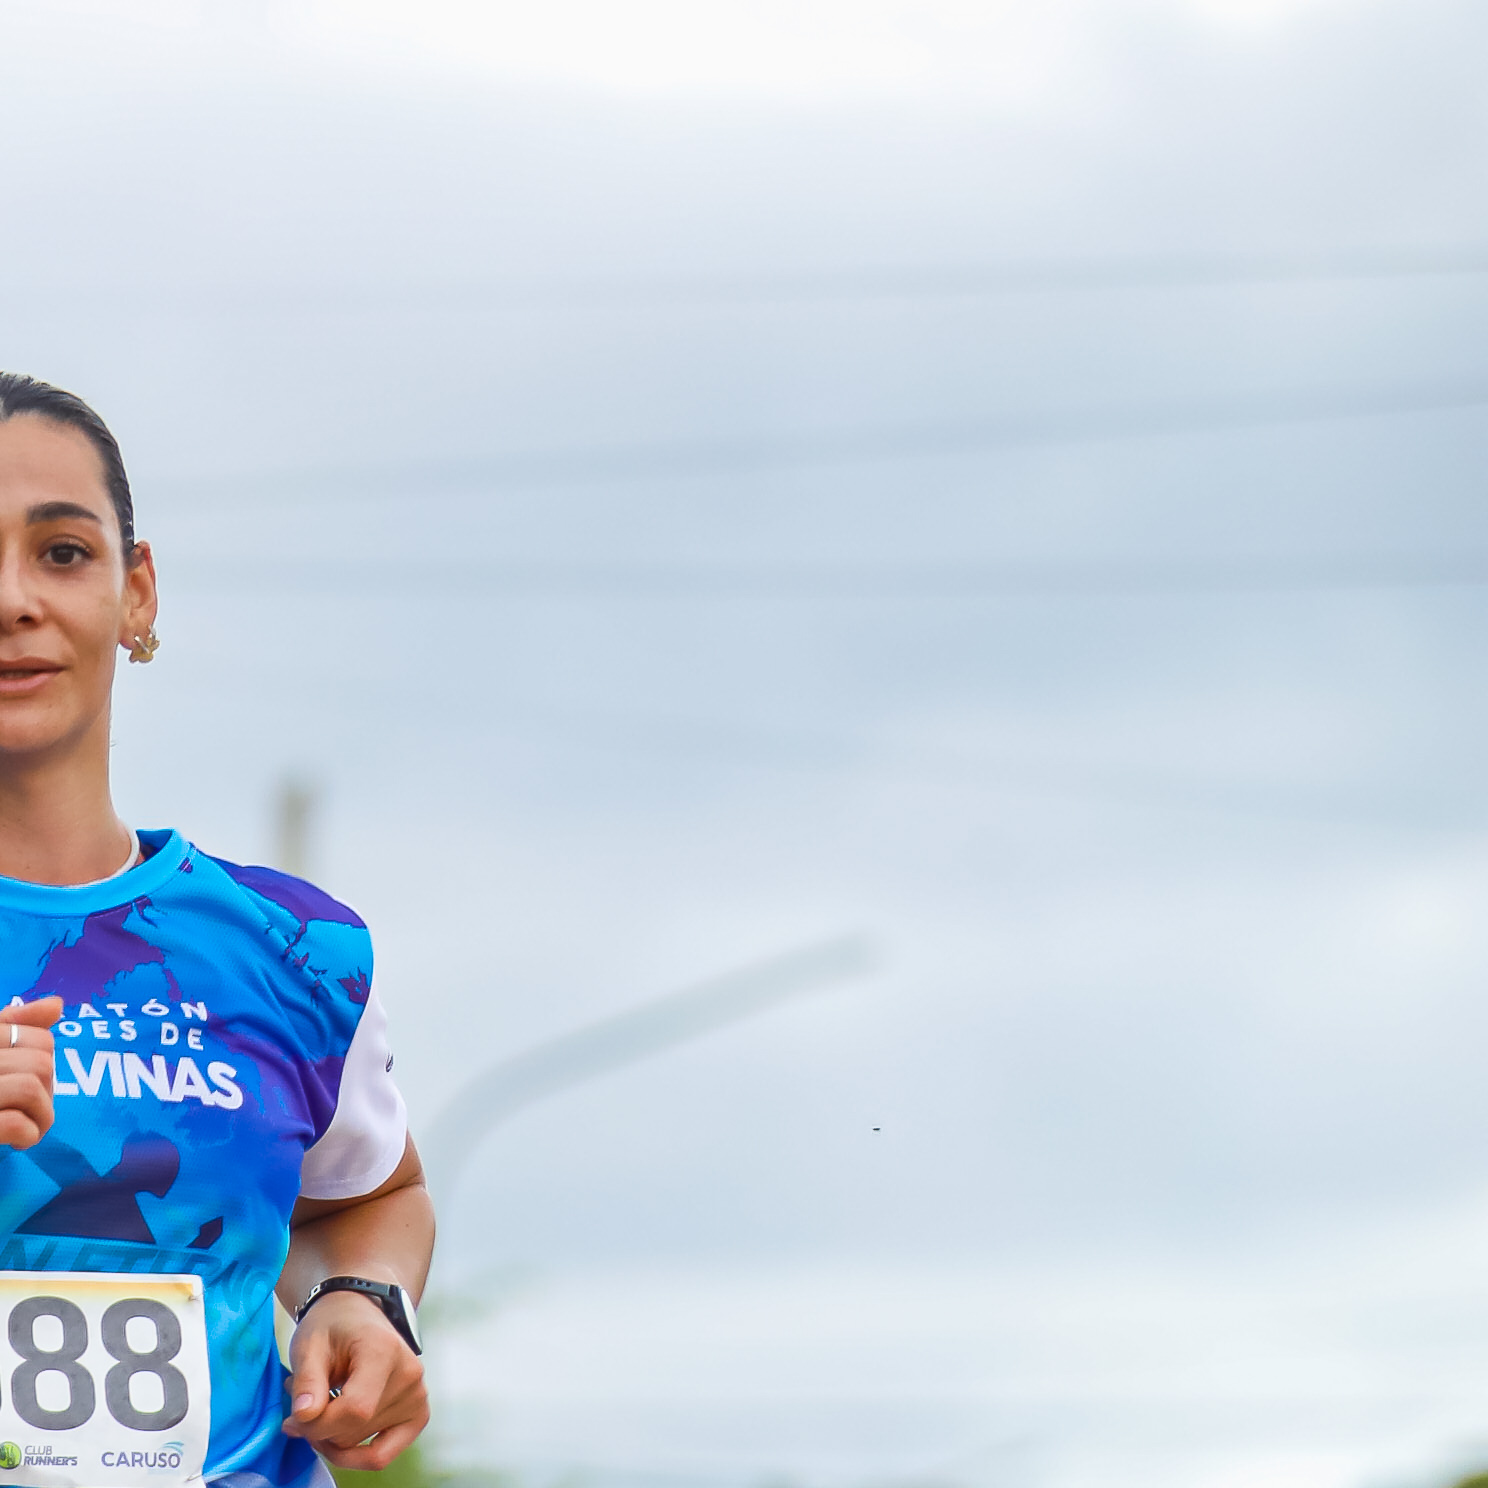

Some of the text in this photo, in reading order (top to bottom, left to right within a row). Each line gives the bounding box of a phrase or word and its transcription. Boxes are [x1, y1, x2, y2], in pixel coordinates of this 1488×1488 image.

[160, 1023, 205, 1050] DE
[53, 1048, 243, 1110] LVINAS
[24, 1445, 53, 1455] CLUB
[23, 1456, 78, 1466] RUNNER'S
[101, 1451, 181, 1469] CARUSO
